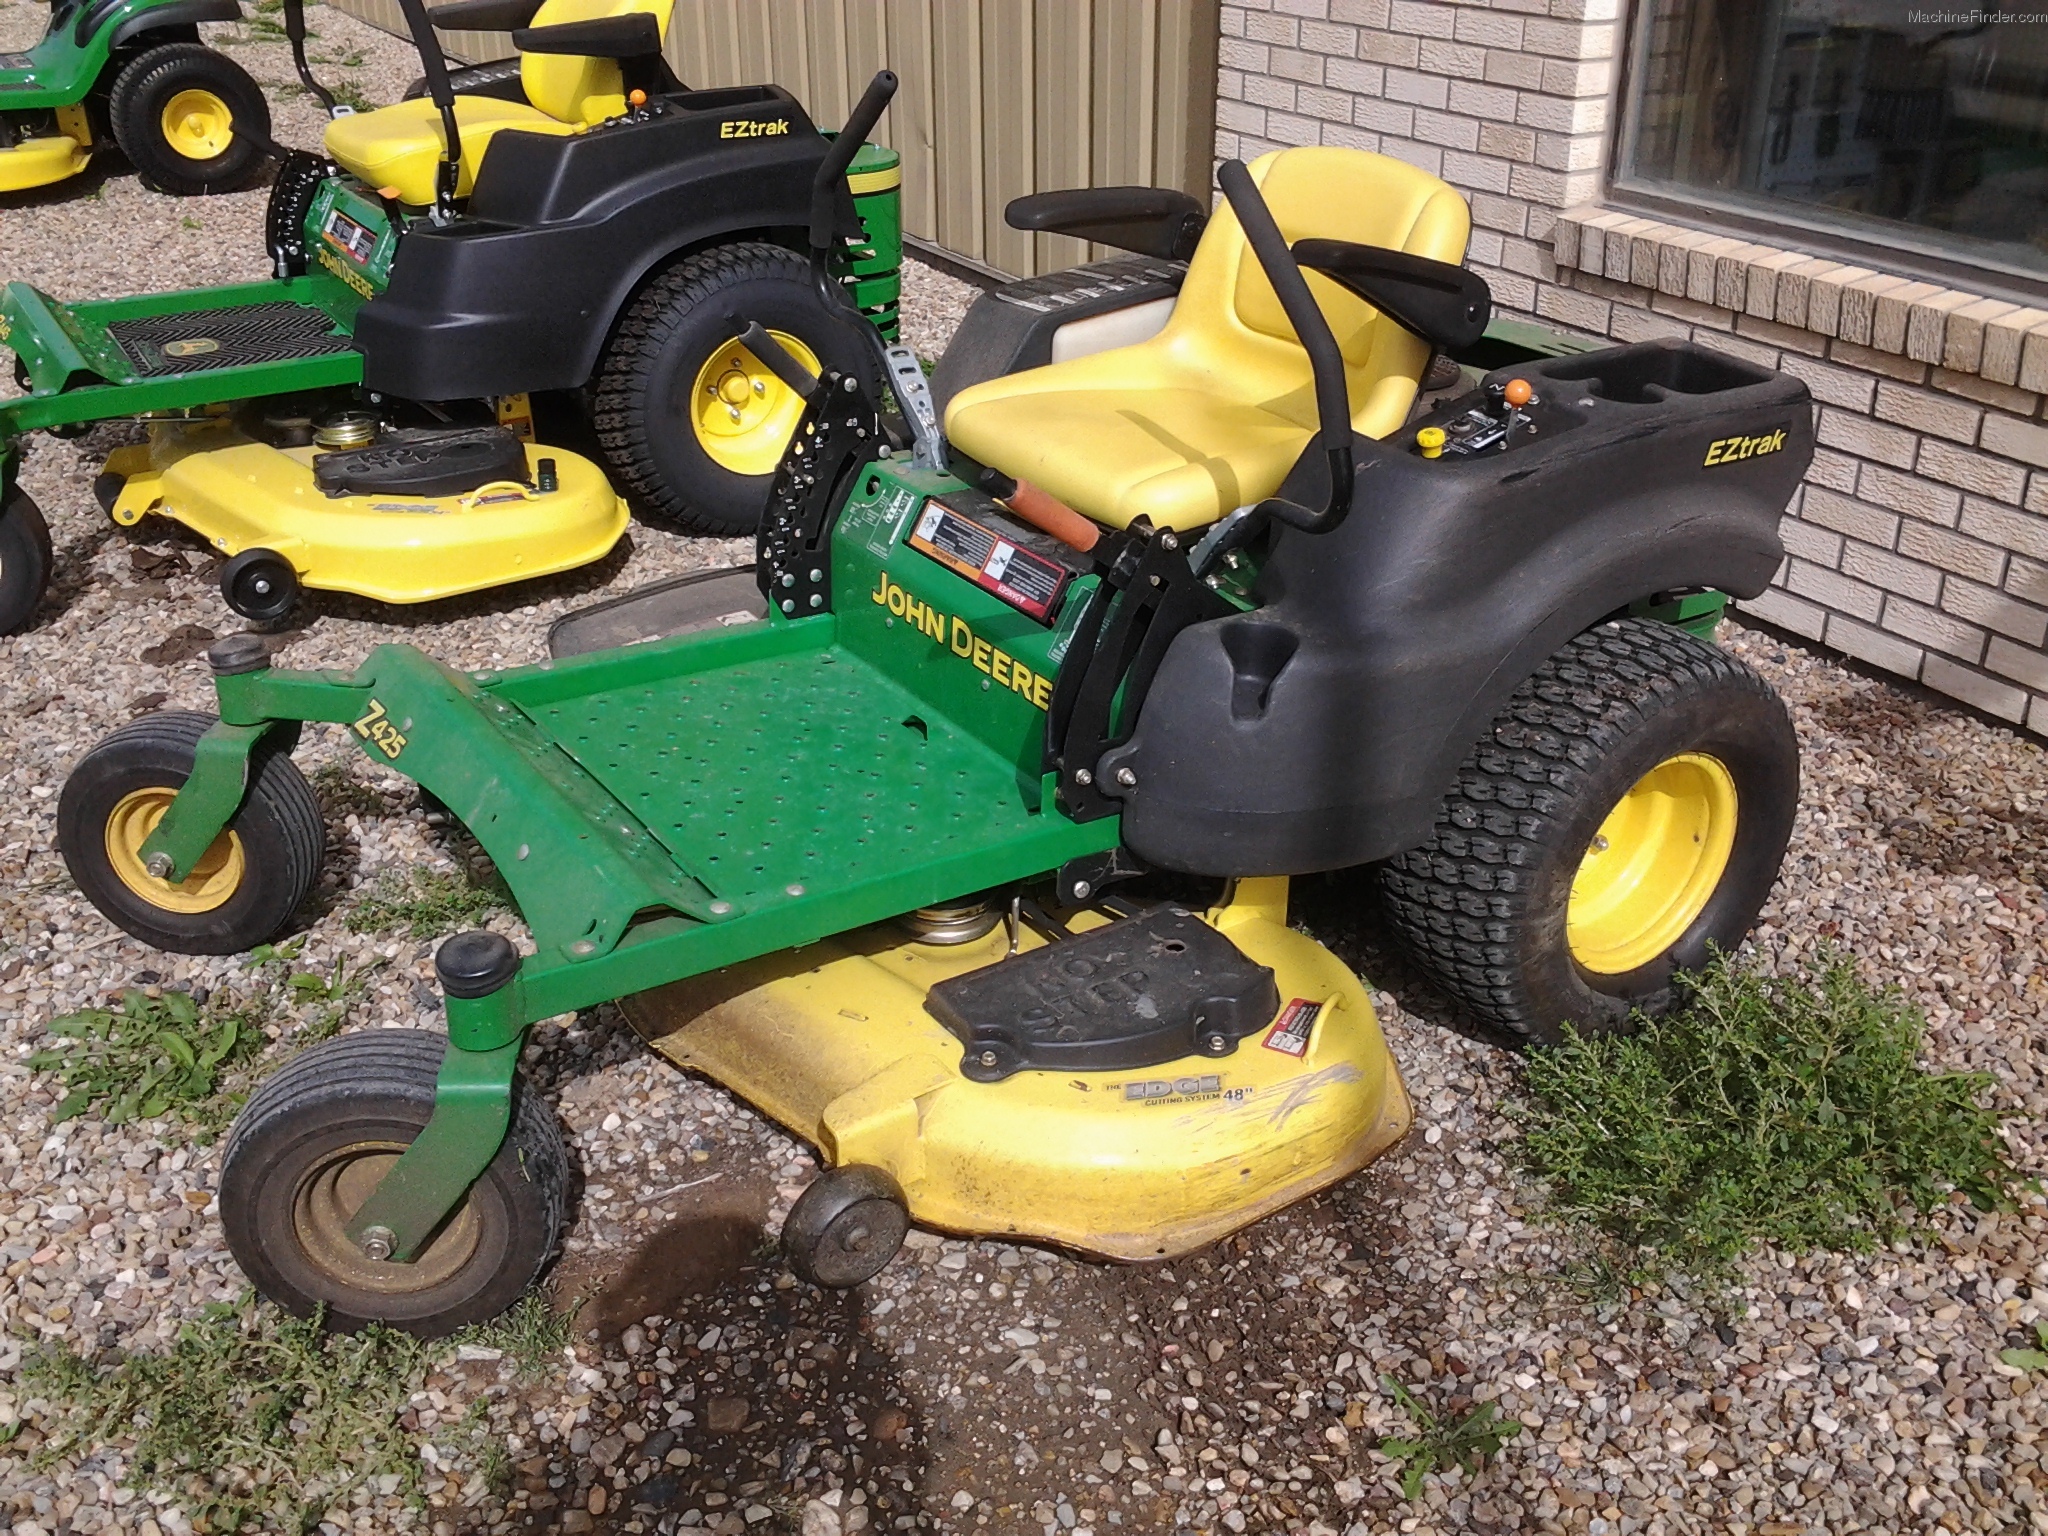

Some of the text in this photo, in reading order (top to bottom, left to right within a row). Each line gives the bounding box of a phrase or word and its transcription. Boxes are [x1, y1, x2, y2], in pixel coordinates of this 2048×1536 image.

[720, 118, 789, 139] EZtrak
[1703, 428, 1787, 467] EZtrak
[872, 570, 946, 645] JOHN
[950, 613, 1053, 712] DEERE
[353, 697, 408, 760] Z425
[1126, 1074, 1220, 1100] EDGE
[1145, 1096, 1183, 1106] CUTTING
[1184, 1092, 1221, 1103] SYSTEM
